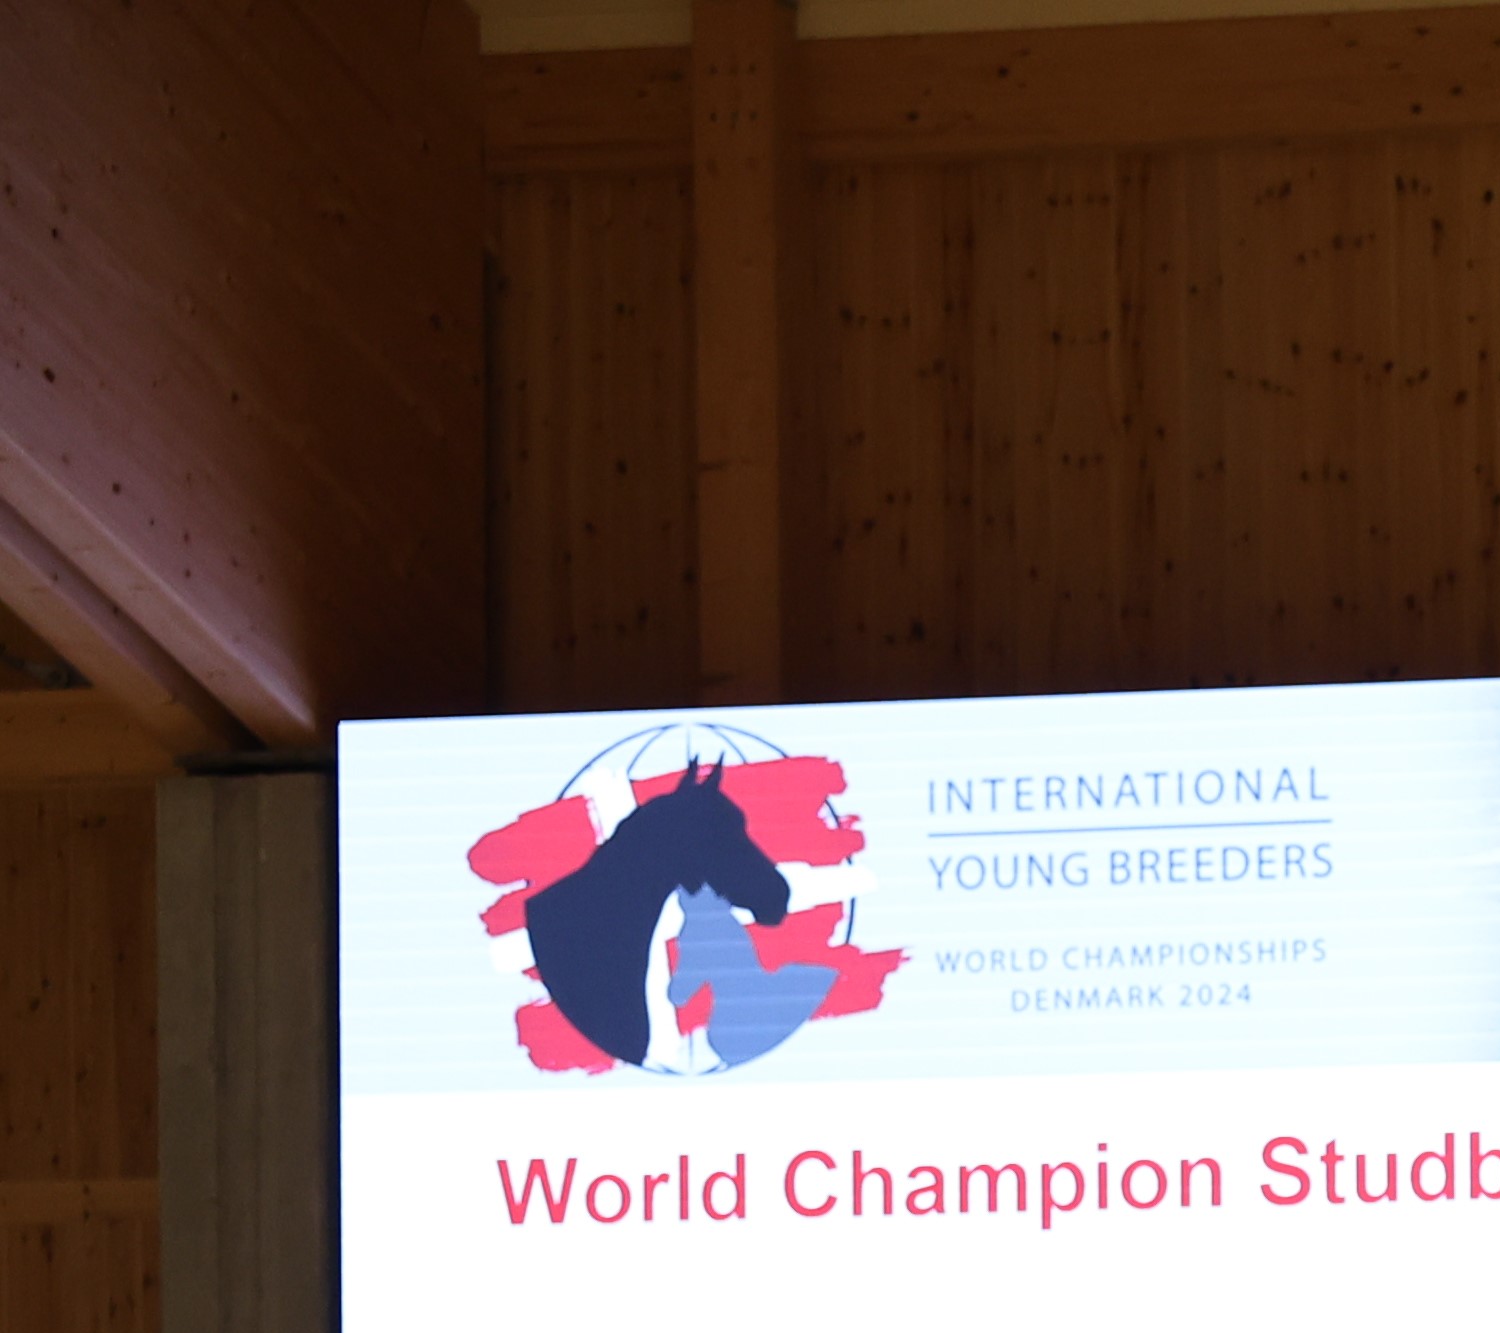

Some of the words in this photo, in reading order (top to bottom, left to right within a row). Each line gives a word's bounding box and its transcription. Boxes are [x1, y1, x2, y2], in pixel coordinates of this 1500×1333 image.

[927, 767, 1332, 814] INTERNATIONAL
[928, 850, 1090, 891] YOUNG
[1108, 843, 1335, 886] BREEDERS
[935, 948, 1050, 974] WORLD
[1061, 938, 1328, 972] CHAMPIONSHIPS
[1009, 986, 1166, 1013] DENMARK
[1180, 983, 1252, 1008] 2024
[496, 1153, 748, 1226] World
[783, 1143, 1224, 1230] Champion
